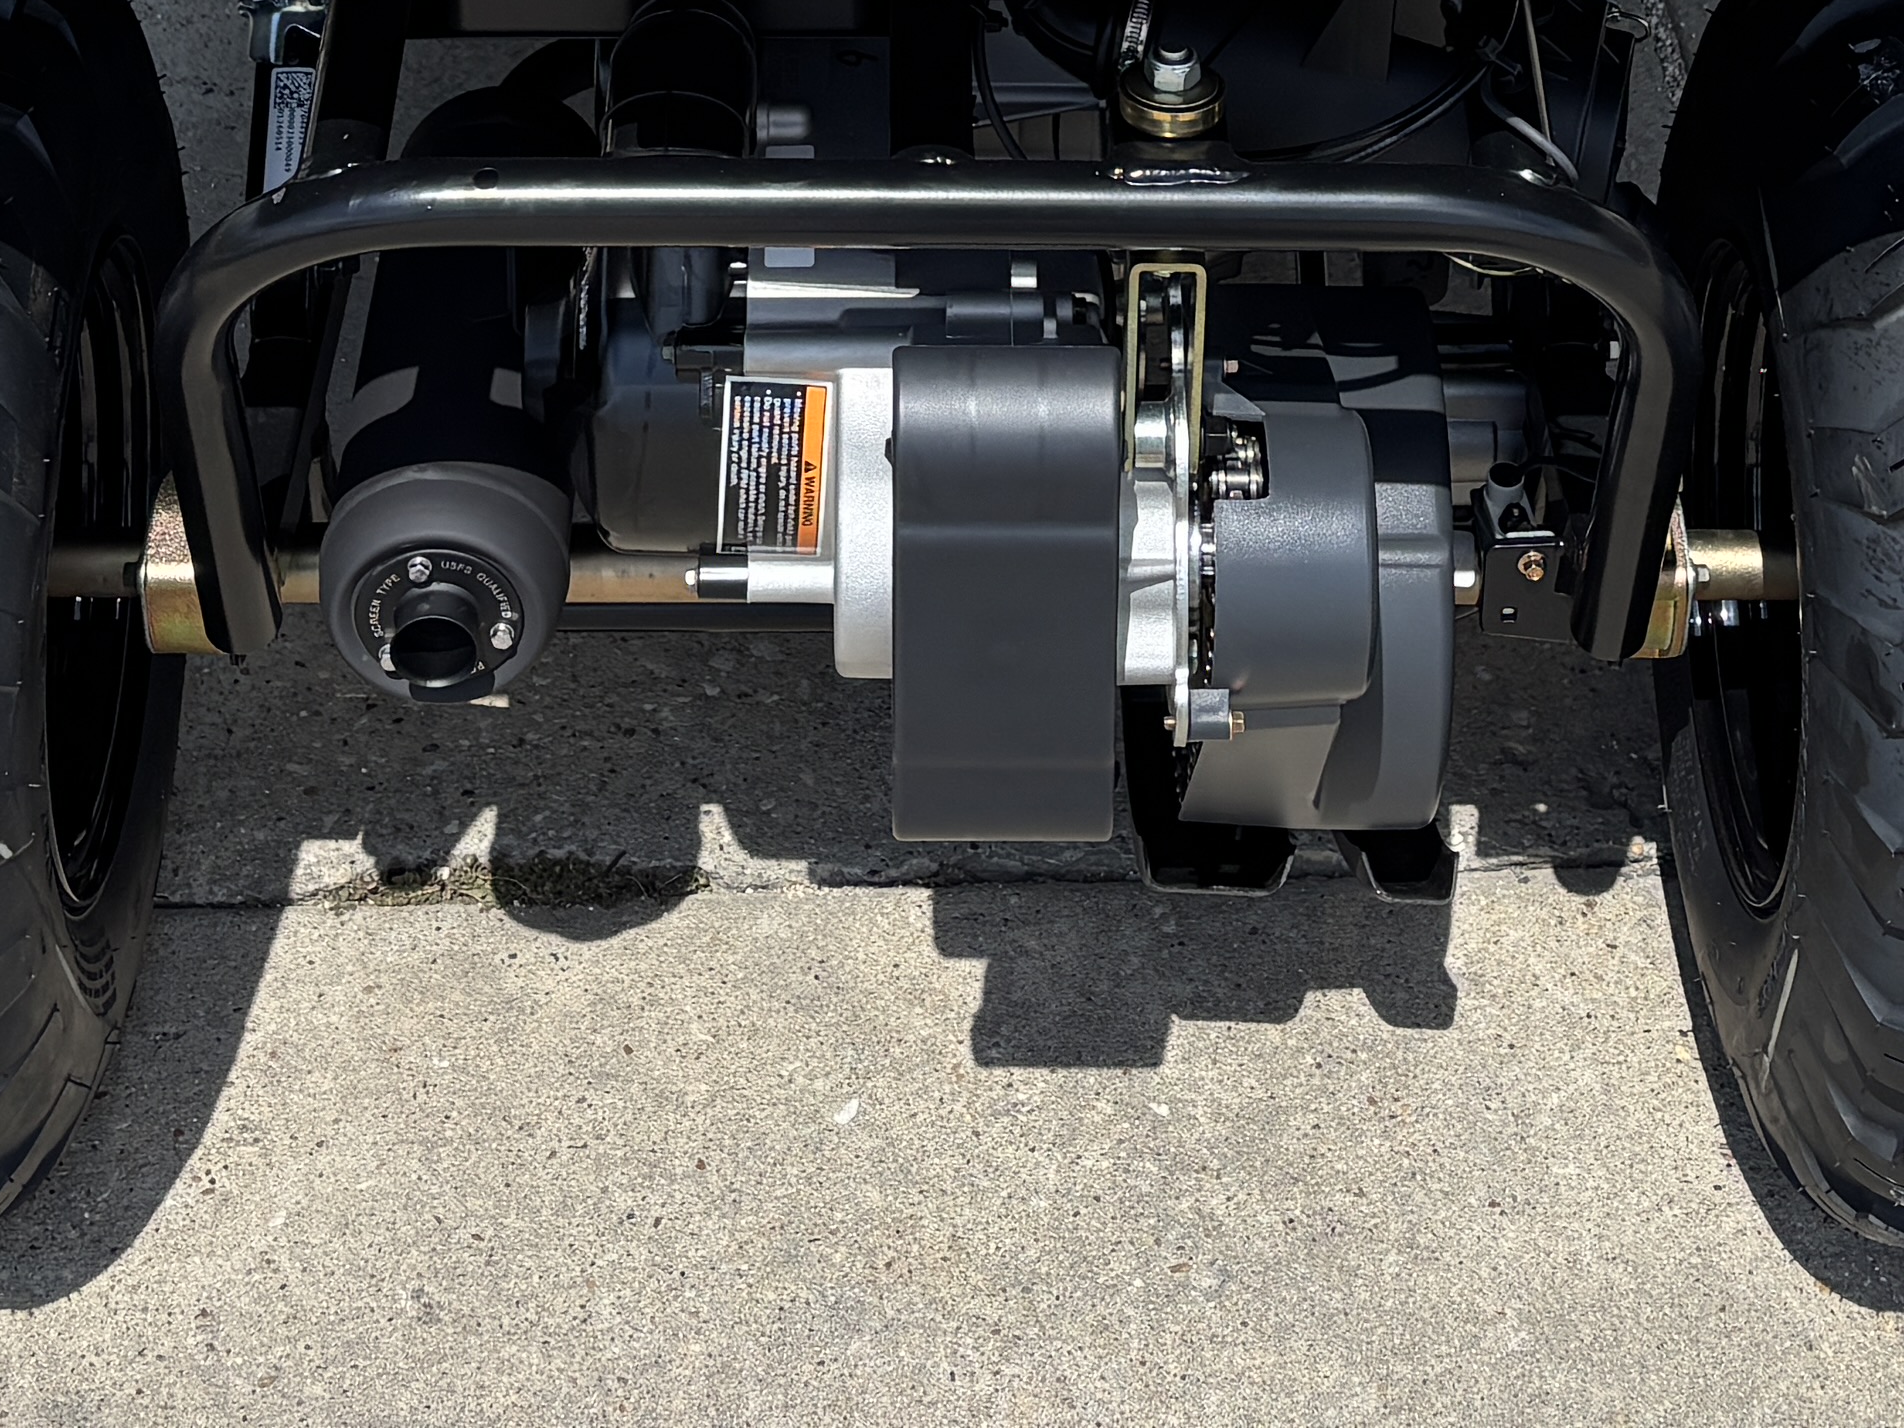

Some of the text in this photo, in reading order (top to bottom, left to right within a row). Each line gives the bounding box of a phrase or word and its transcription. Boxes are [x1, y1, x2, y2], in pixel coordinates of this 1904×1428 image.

[802, 476, 816, 526] WARNING
[369, 574, 400, 637] SCREEN TYPE
[477, 573, 512, 618] QUALIFIED
